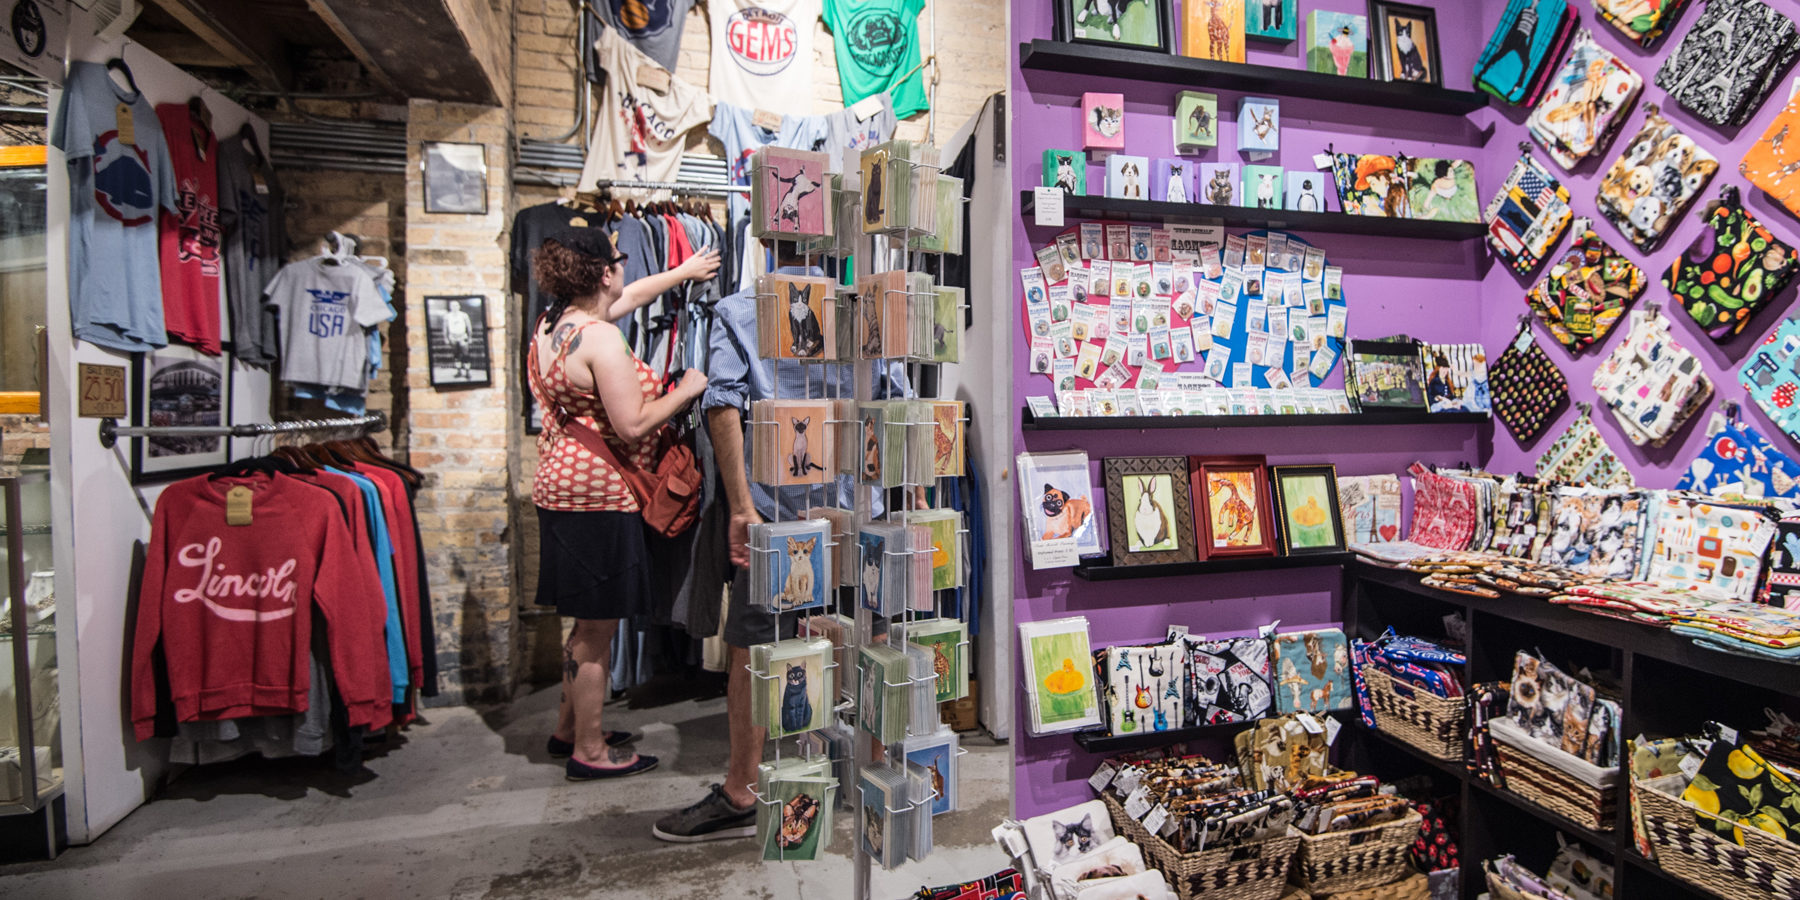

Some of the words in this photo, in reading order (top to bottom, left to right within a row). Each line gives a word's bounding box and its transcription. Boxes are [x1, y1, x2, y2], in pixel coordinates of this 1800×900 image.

[729, 20, 794, 61] GEMS
[309, 312, 344, 338] USA
[174, 536, 297, 622] Lincoln
